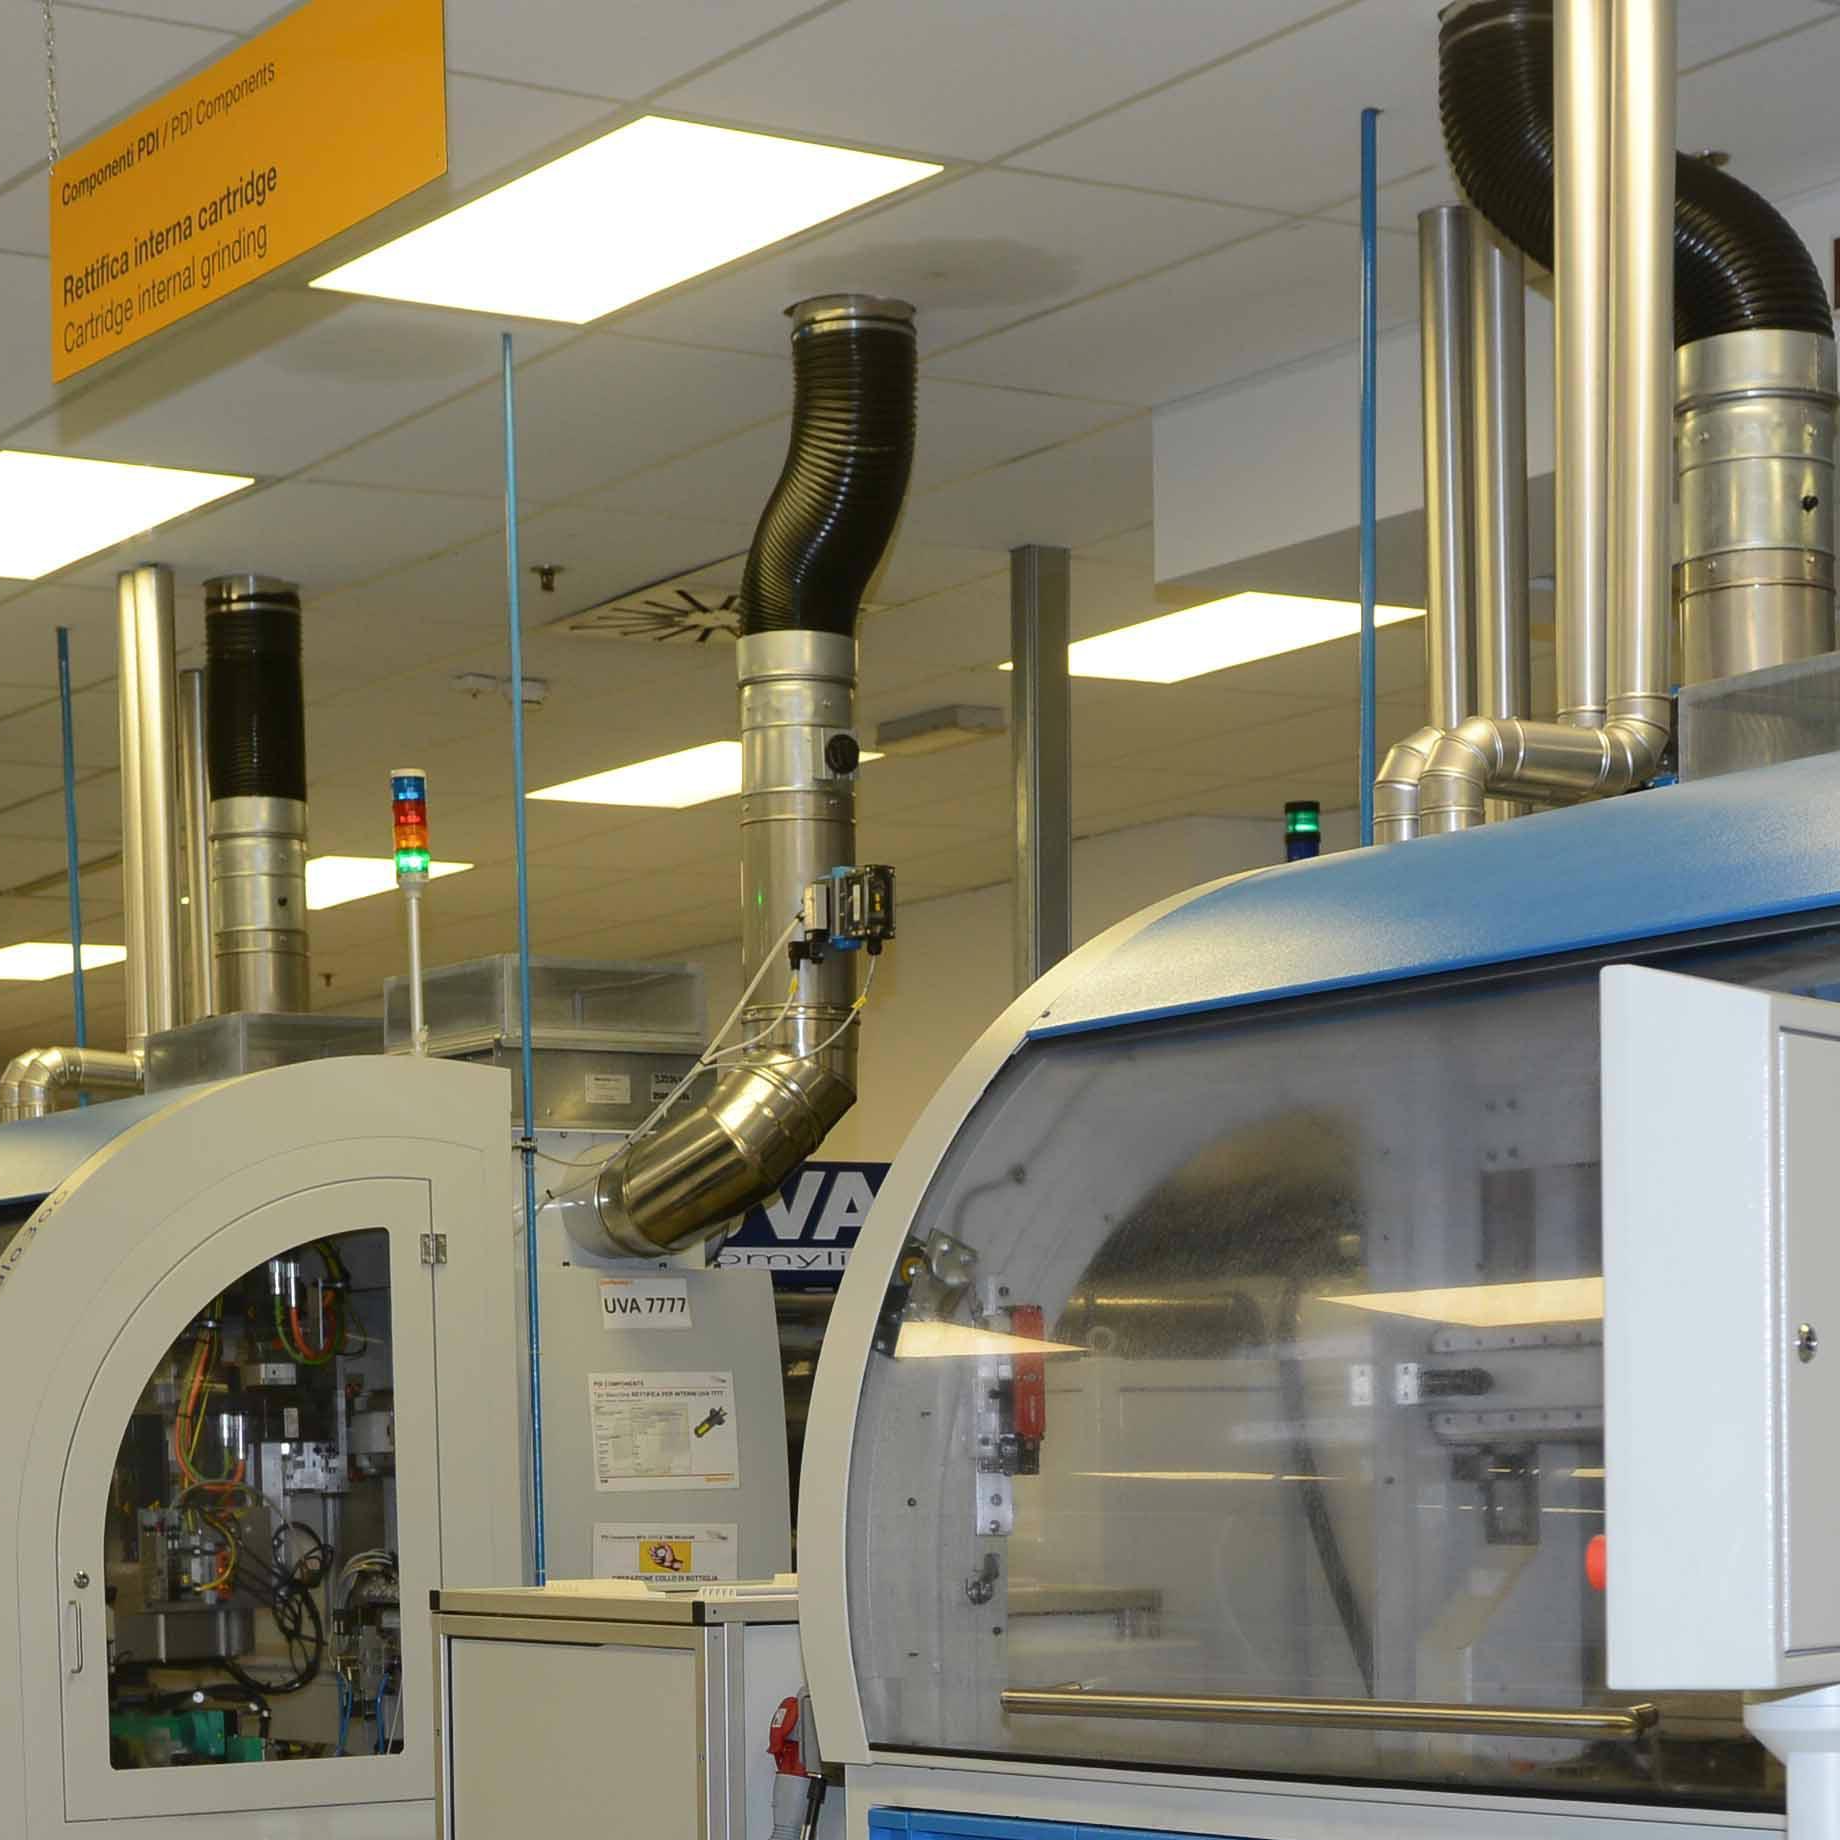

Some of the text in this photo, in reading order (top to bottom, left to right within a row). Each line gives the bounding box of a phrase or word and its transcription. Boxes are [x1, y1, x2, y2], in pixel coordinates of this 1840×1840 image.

[62, 143, 134, 206] Componenti
[137, 127, 159, 159] PDI
[170, 109, 193, 143] PDI
[195, 61, 275, 126] Components
[63, 165, 277, 306] Rettifica interna cartridge
[63, 223, 268, 354] Cartridge internal grinding
[762, 1170, 879, 1241] VA
[603, 1297, 687, 1314] UVA 7777
